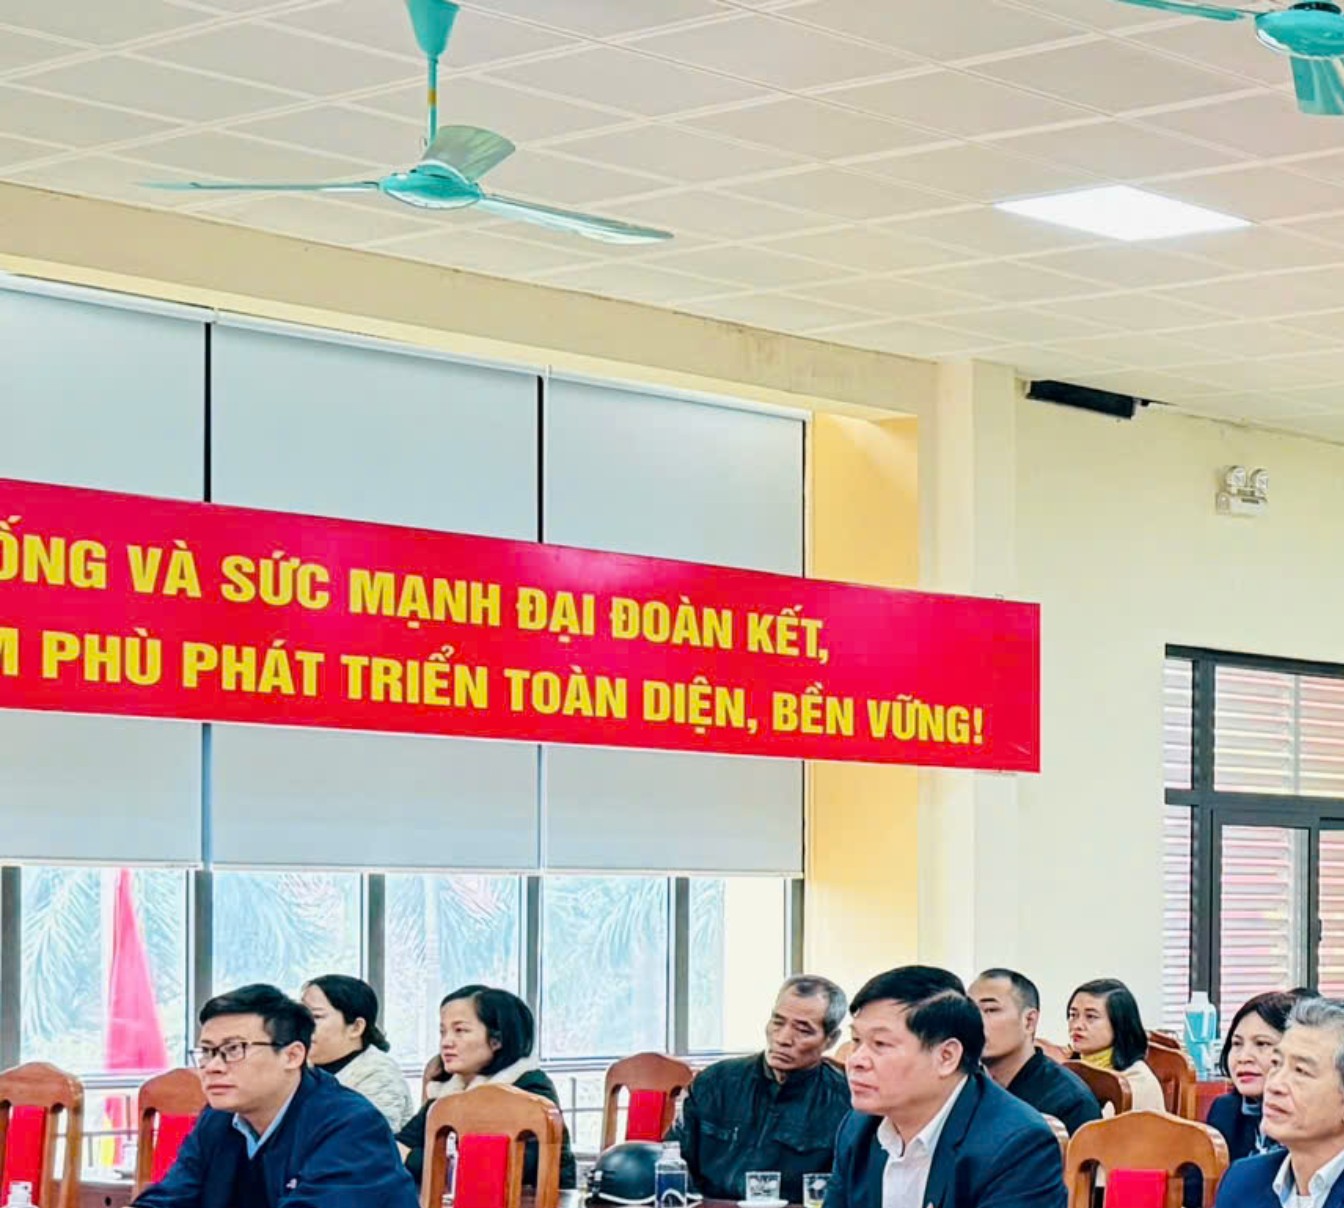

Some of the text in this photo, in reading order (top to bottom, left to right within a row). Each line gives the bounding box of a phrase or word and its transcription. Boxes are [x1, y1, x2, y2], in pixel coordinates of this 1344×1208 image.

[127, 539, 202, 599] VÀ
[220, 549, 331, 611] SỨC
[348, 568, 502, 630] MẠNH
[515, 587, 596, 644] ĐẠI
[608, 595, 734, 651] ĐOÀN
[746, 603, 830, 664] KẾT,
[41, 627, 162, 686] PHÙ
[181, 639, 326, 697] PHÁT
[339, 644, 489, 710] TRIỂN
[502, 660, 628, 720] TOÀN
[642, 675, 759, 735] DIỆN,
[771, 682, 855, 737] BỀN
[865, 692, 984, 746] VỮNG!
